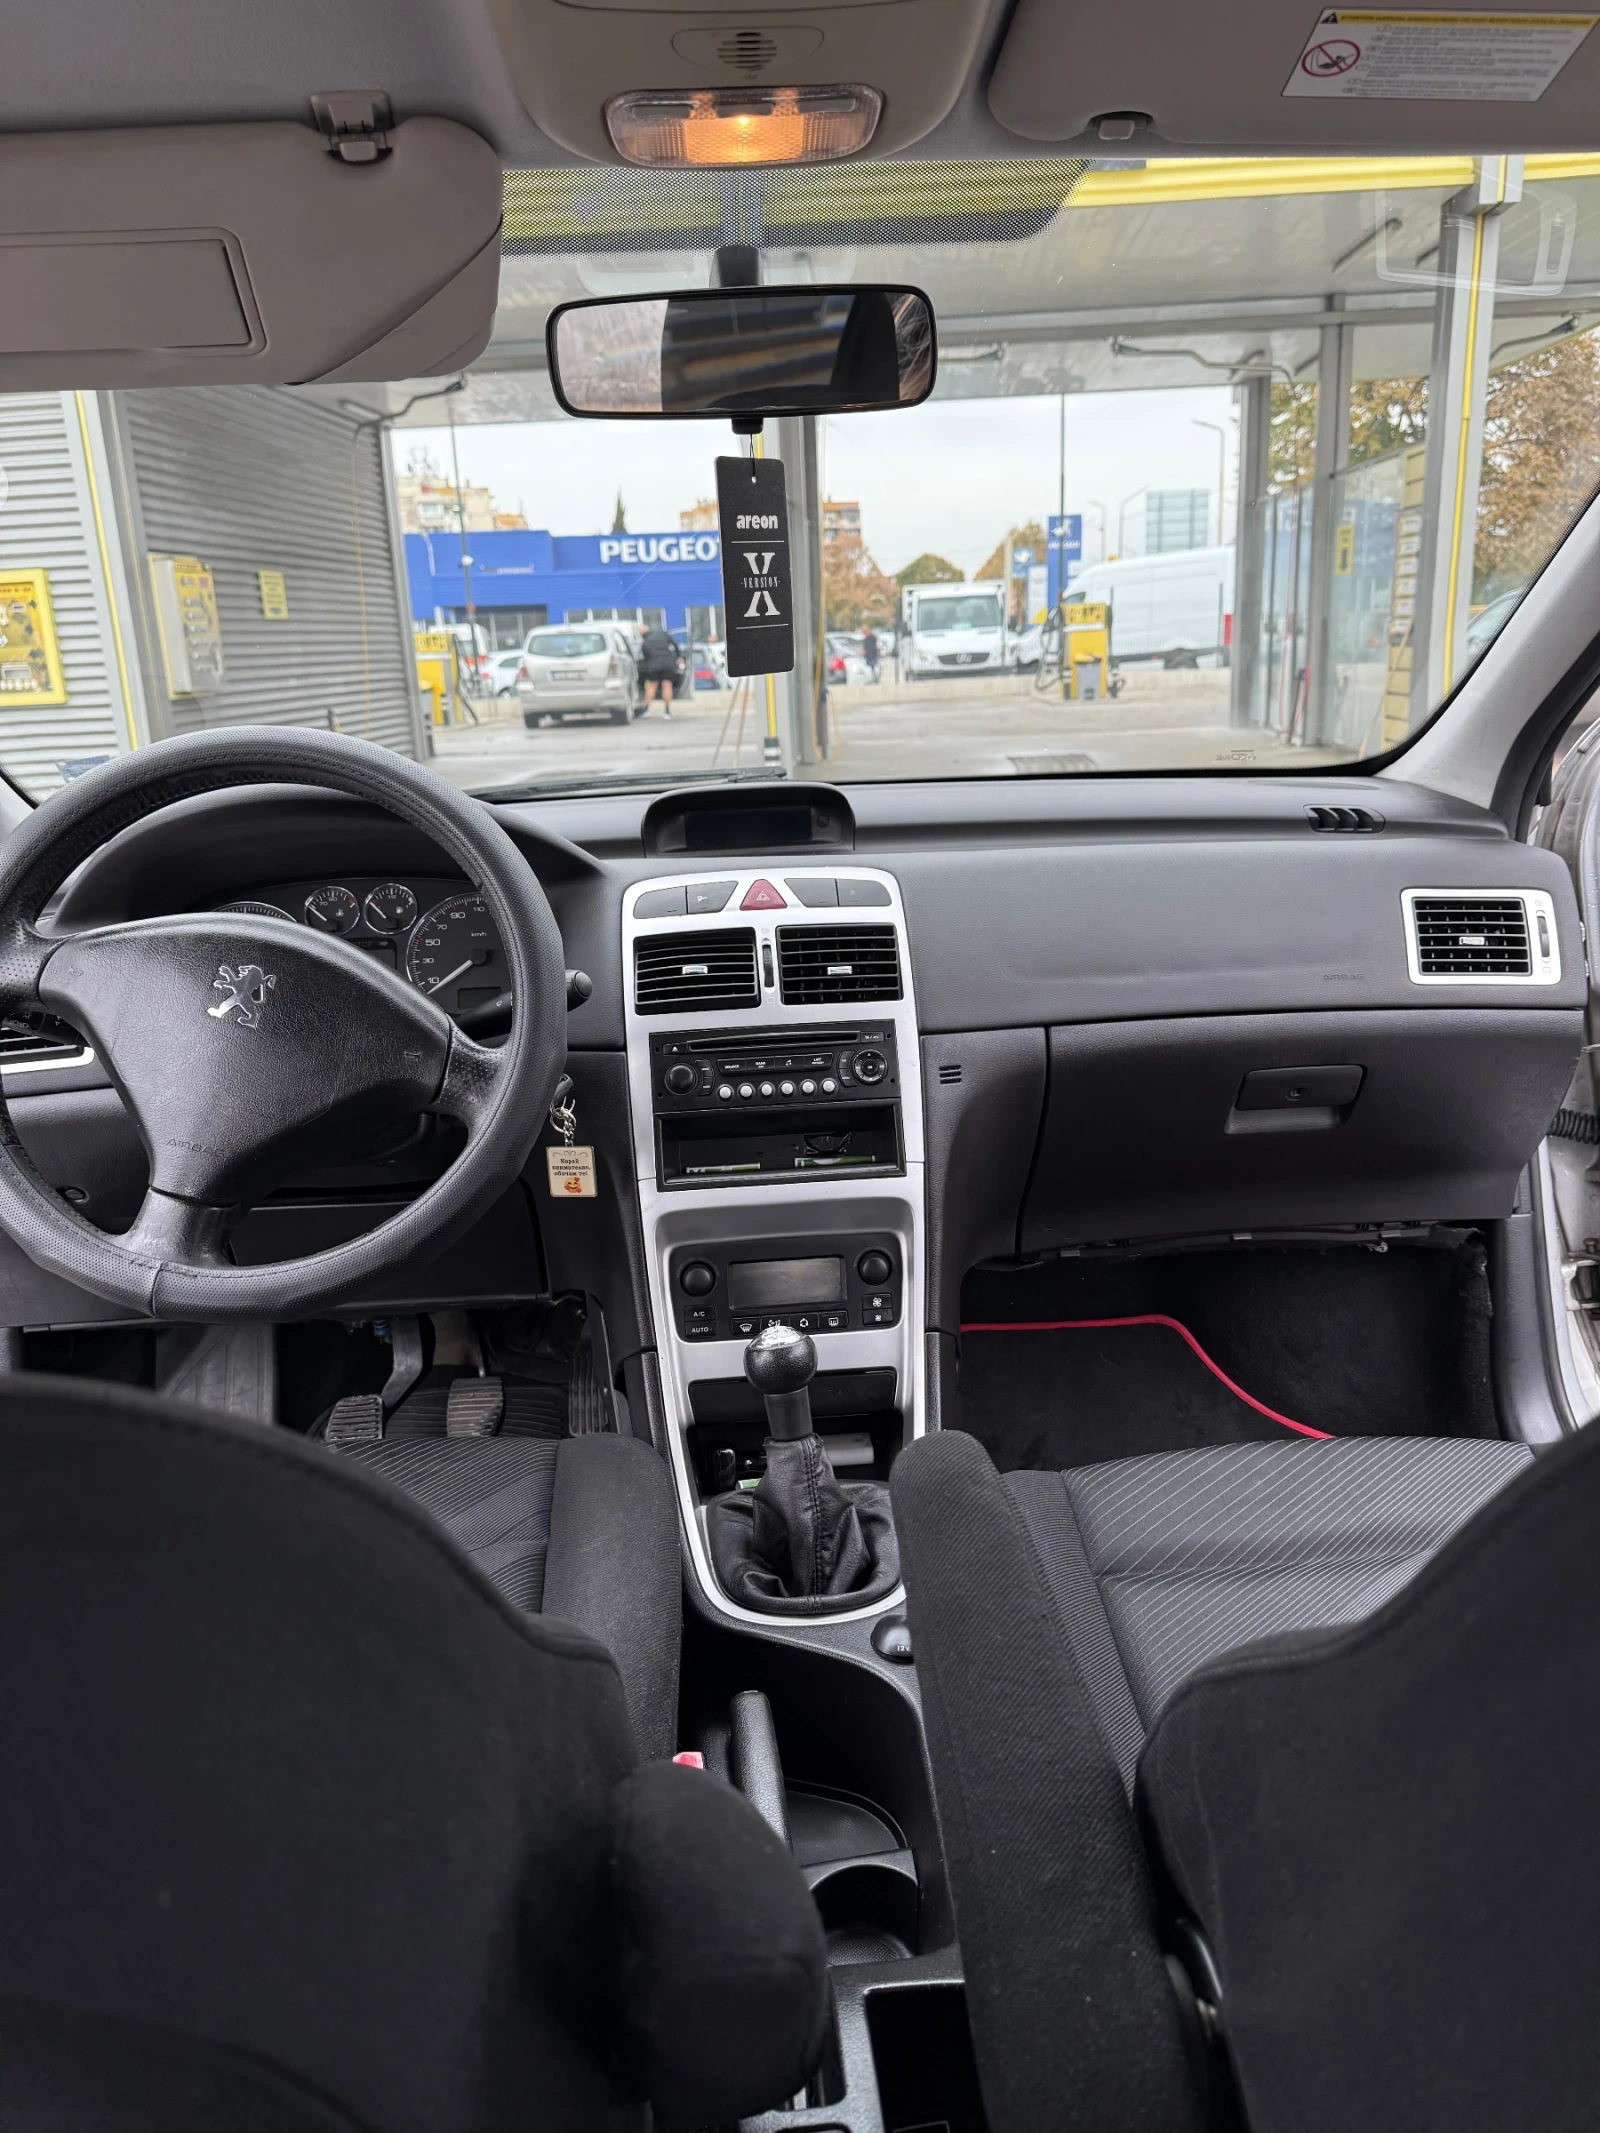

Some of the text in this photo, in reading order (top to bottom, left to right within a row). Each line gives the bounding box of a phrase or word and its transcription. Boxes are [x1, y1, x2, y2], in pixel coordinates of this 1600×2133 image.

[736, 514, 778, 530] areon
[600, 536, 720, 564] PEUGEO
[425, 938, 441, 946] 50
[427, 976, 440, 984] 10
[166, 1138, 226, 1158] AIRBAG
